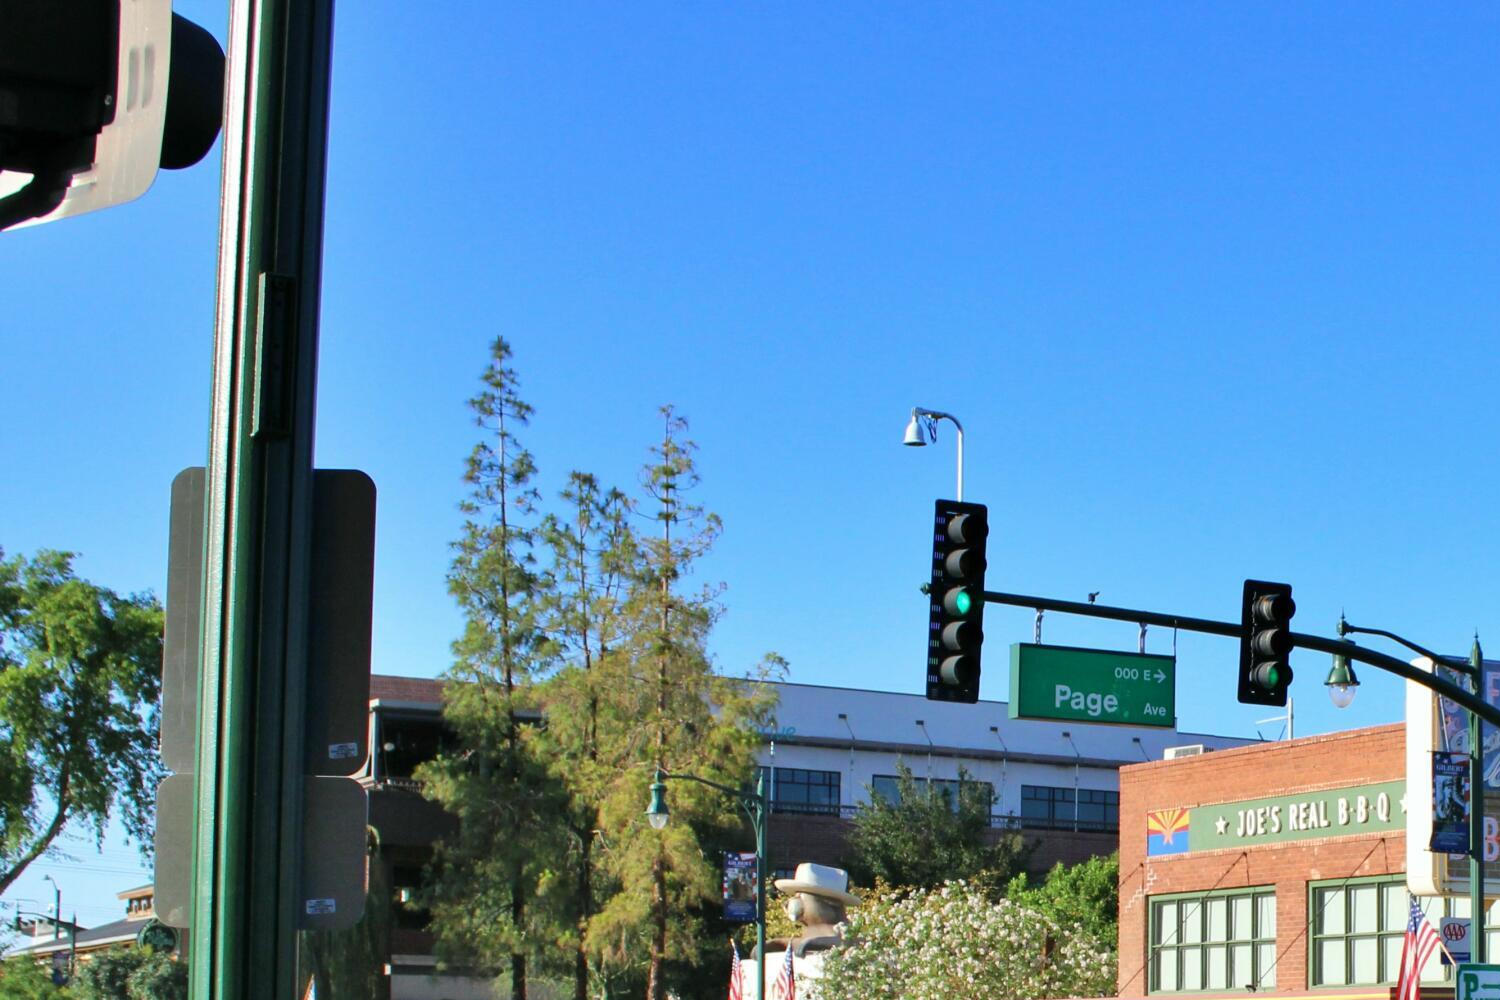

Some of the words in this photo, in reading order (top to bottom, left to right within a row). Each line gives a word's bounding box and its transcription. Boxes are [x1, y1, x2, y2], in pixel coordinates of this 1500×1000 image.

[1114, 667, 1139, 680] 000
[1143, 669, 1151, 681] E
[1055, 684, 1119, 717] Page
[1143, 703, 1167, 716] Ave
[1236, 805, 1282, 837] JOE'S
[1288, 800, 1330, 832] REAL
[1444, 924, 1465, 941] AAA
